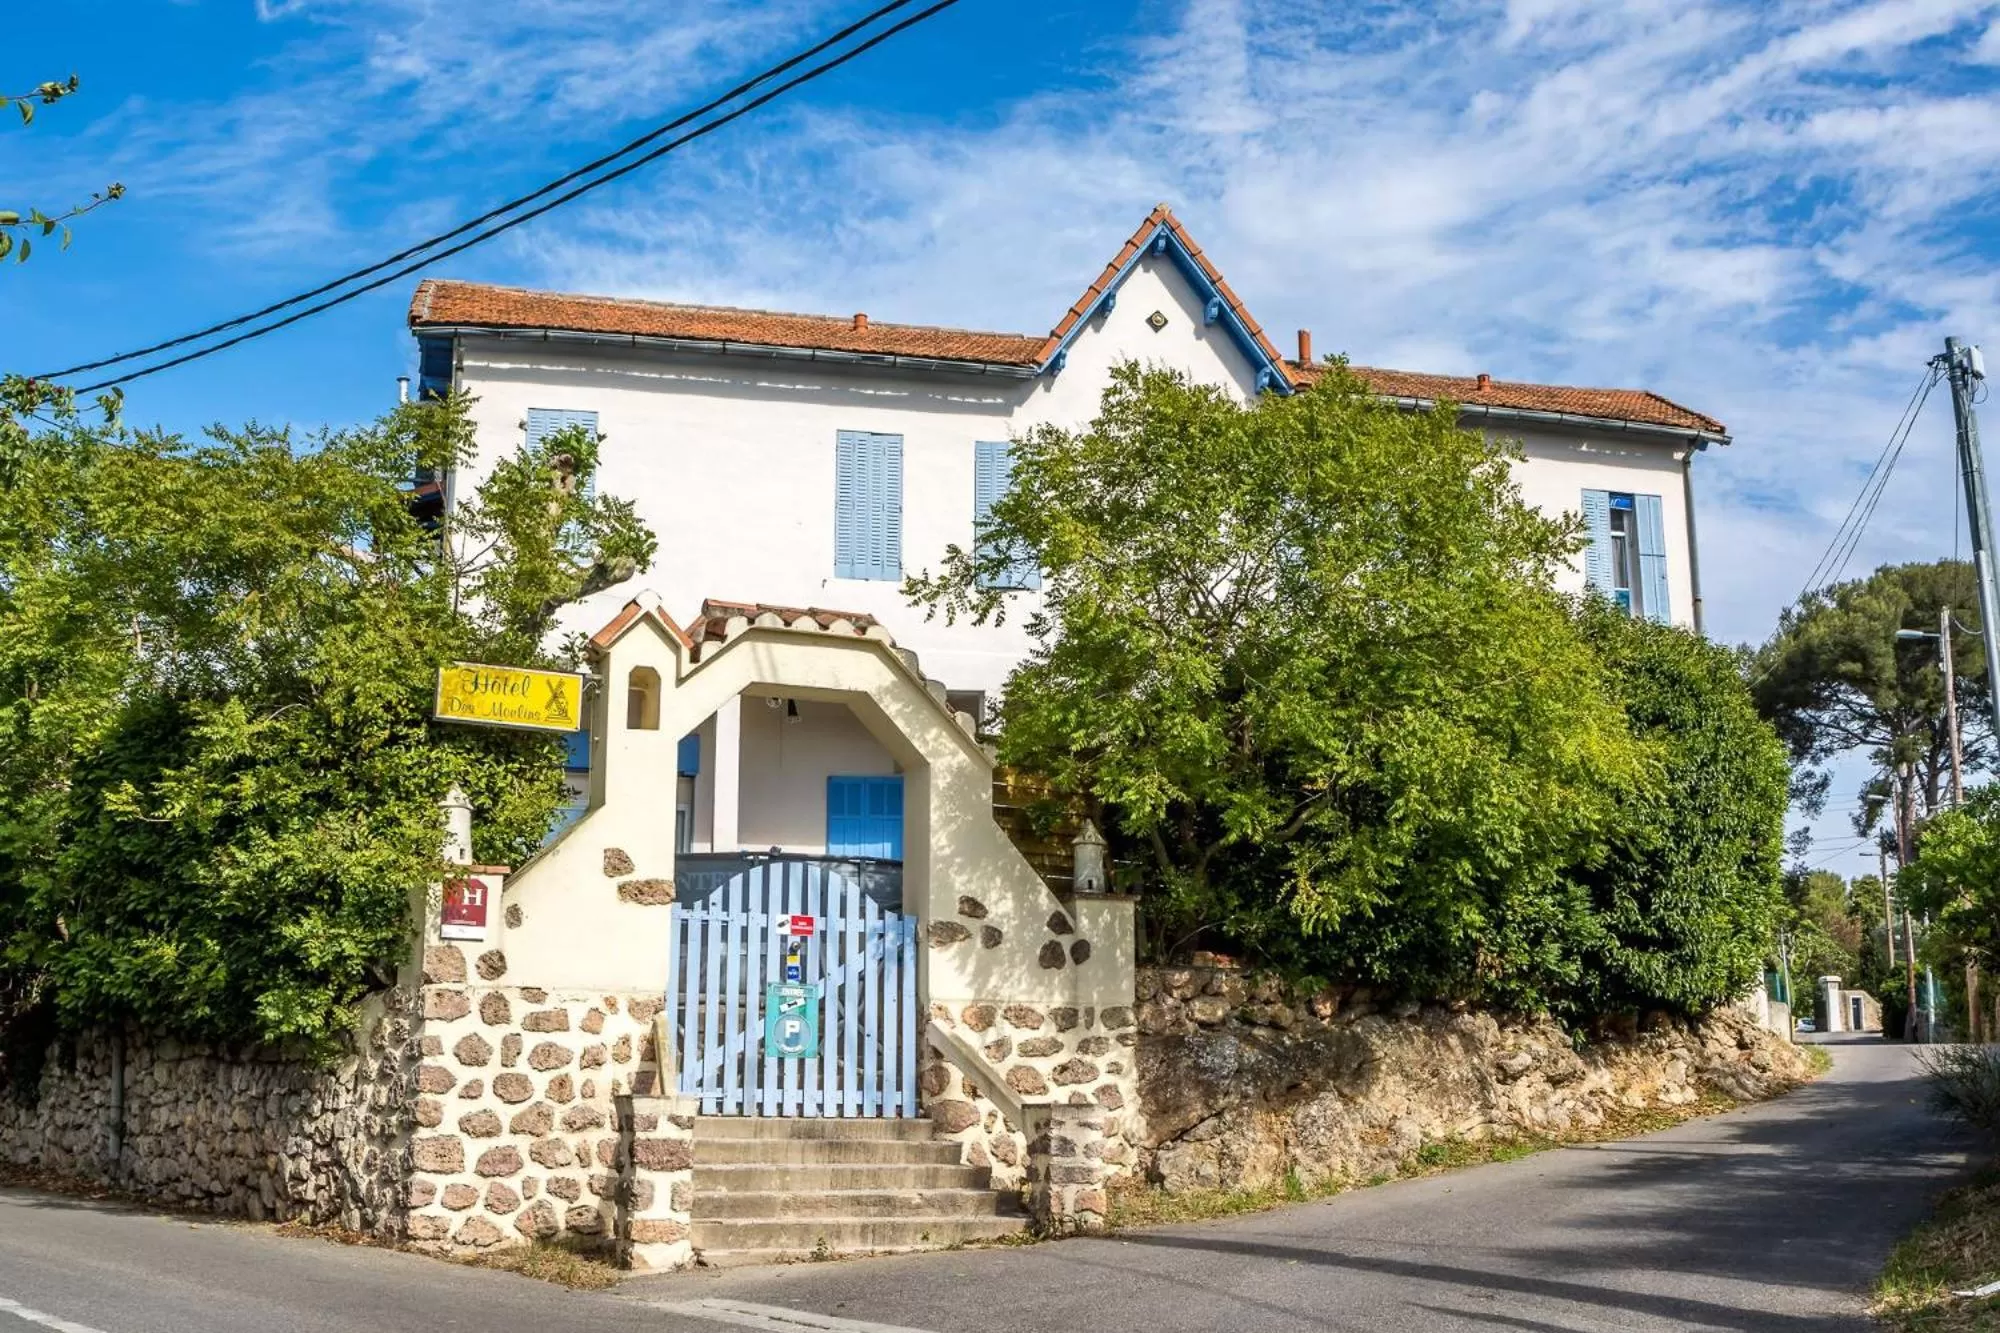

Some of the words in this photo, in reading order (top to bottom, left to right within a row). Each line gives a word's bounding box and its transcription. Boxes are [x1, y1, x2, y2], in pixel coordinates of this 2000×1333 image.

[460, 668, 530, 698] Hôtel
[482, 702, 541, 721] Moulins
[461, 887, 484, 906] H
[785, 1020, 801, 1038] P
